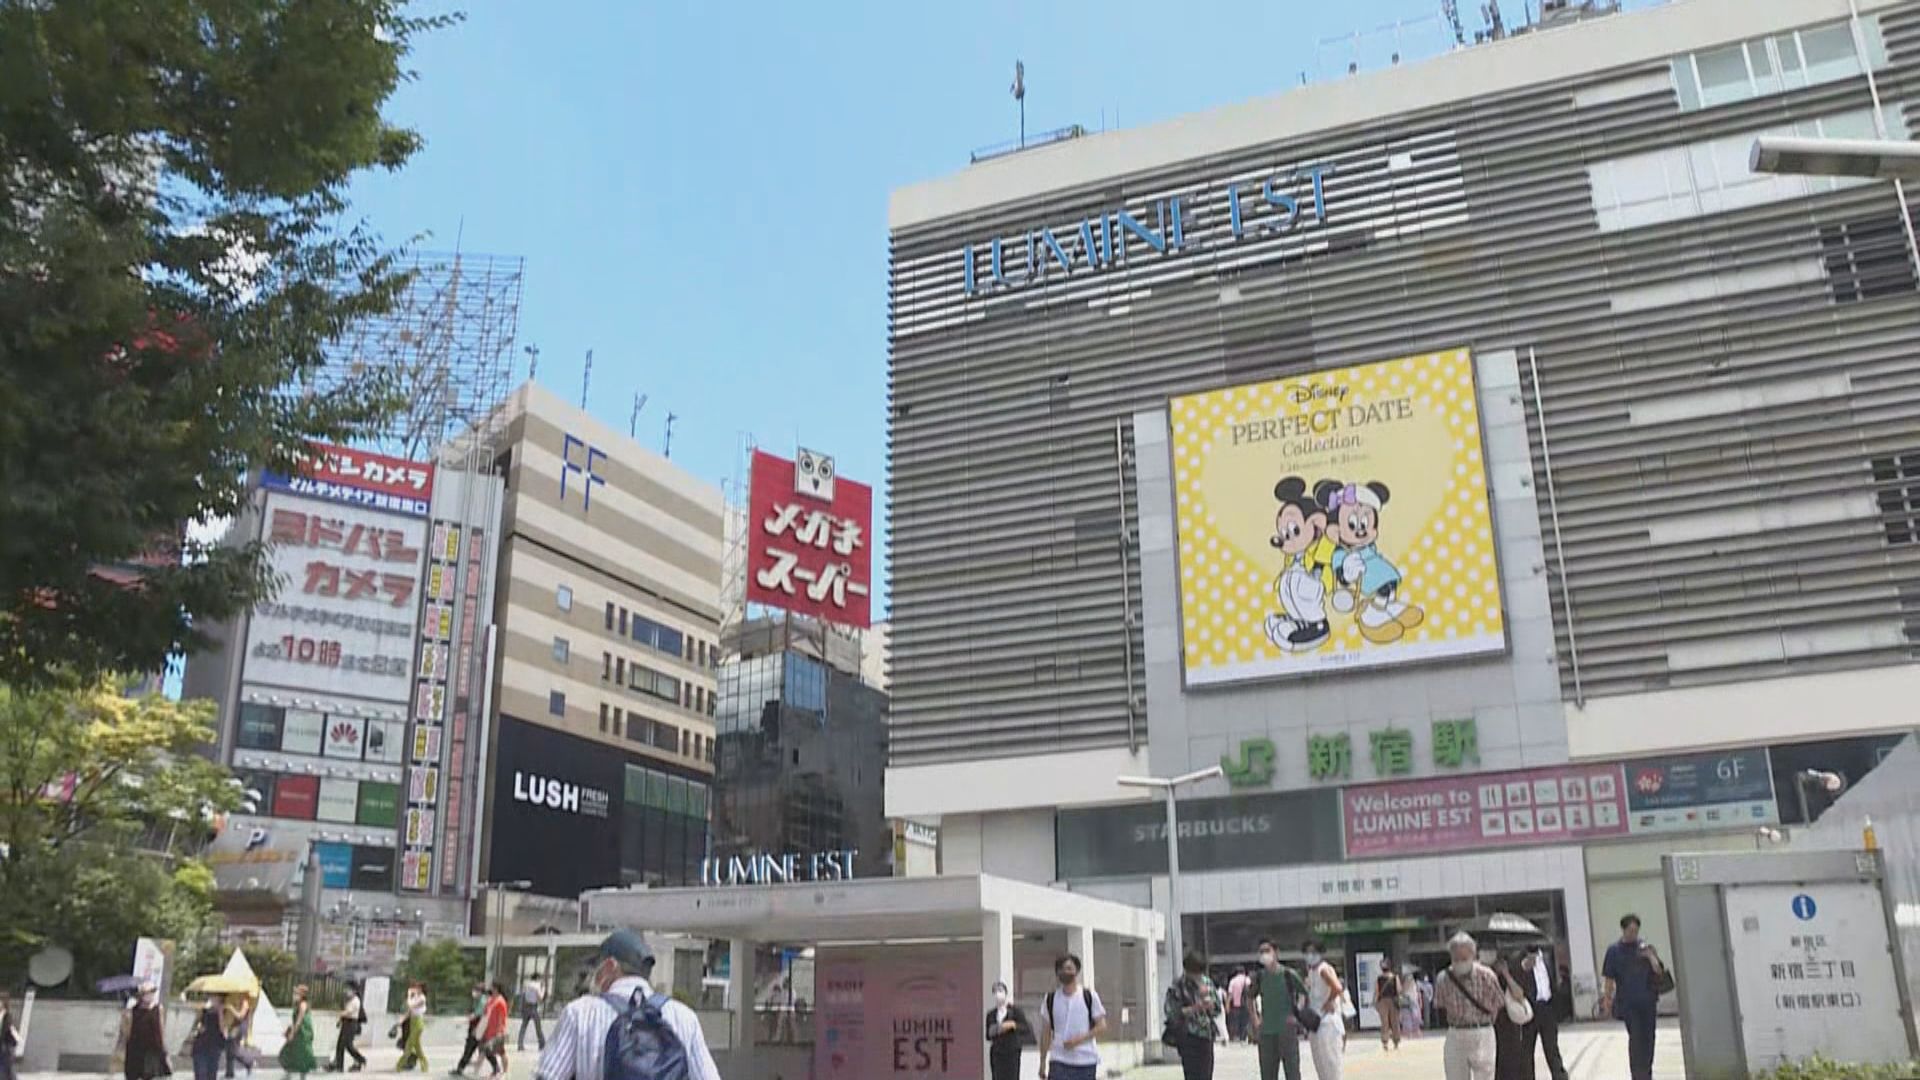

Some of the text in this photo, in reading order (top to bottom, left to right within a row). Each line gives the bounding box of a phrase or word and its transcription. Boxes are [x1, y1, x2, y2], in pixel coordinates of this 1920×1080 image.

[963, 162, 1337, 299] LUMINE EST
[1286, 383, 1349, 405] Disney
[1232, 397, 1413, 446] PERFECT DATE
[1282, 433, 1361, 459] Collection
[271, 508, 419, 564] ヨドバシ
[763, 502, 864, 556] メガネ
[303, 561, 416, 608] カメラ
[756, 547, 869, 608] スーパー
[1219, 717, 1479, 787] JR 新宿駅
[1716, 758, 1745, 780] 6F
[514, 769, 580, 813] LUSH
[1351, 789, 1472, 813] Welcome to
[1353, 806, 1472, 834] LUMINE EST
[702, 849, 859, 886] LUMINE EST
[893, 1017, 953, 1035] LUMINE
[893, 1036, 955, 1073] EST
